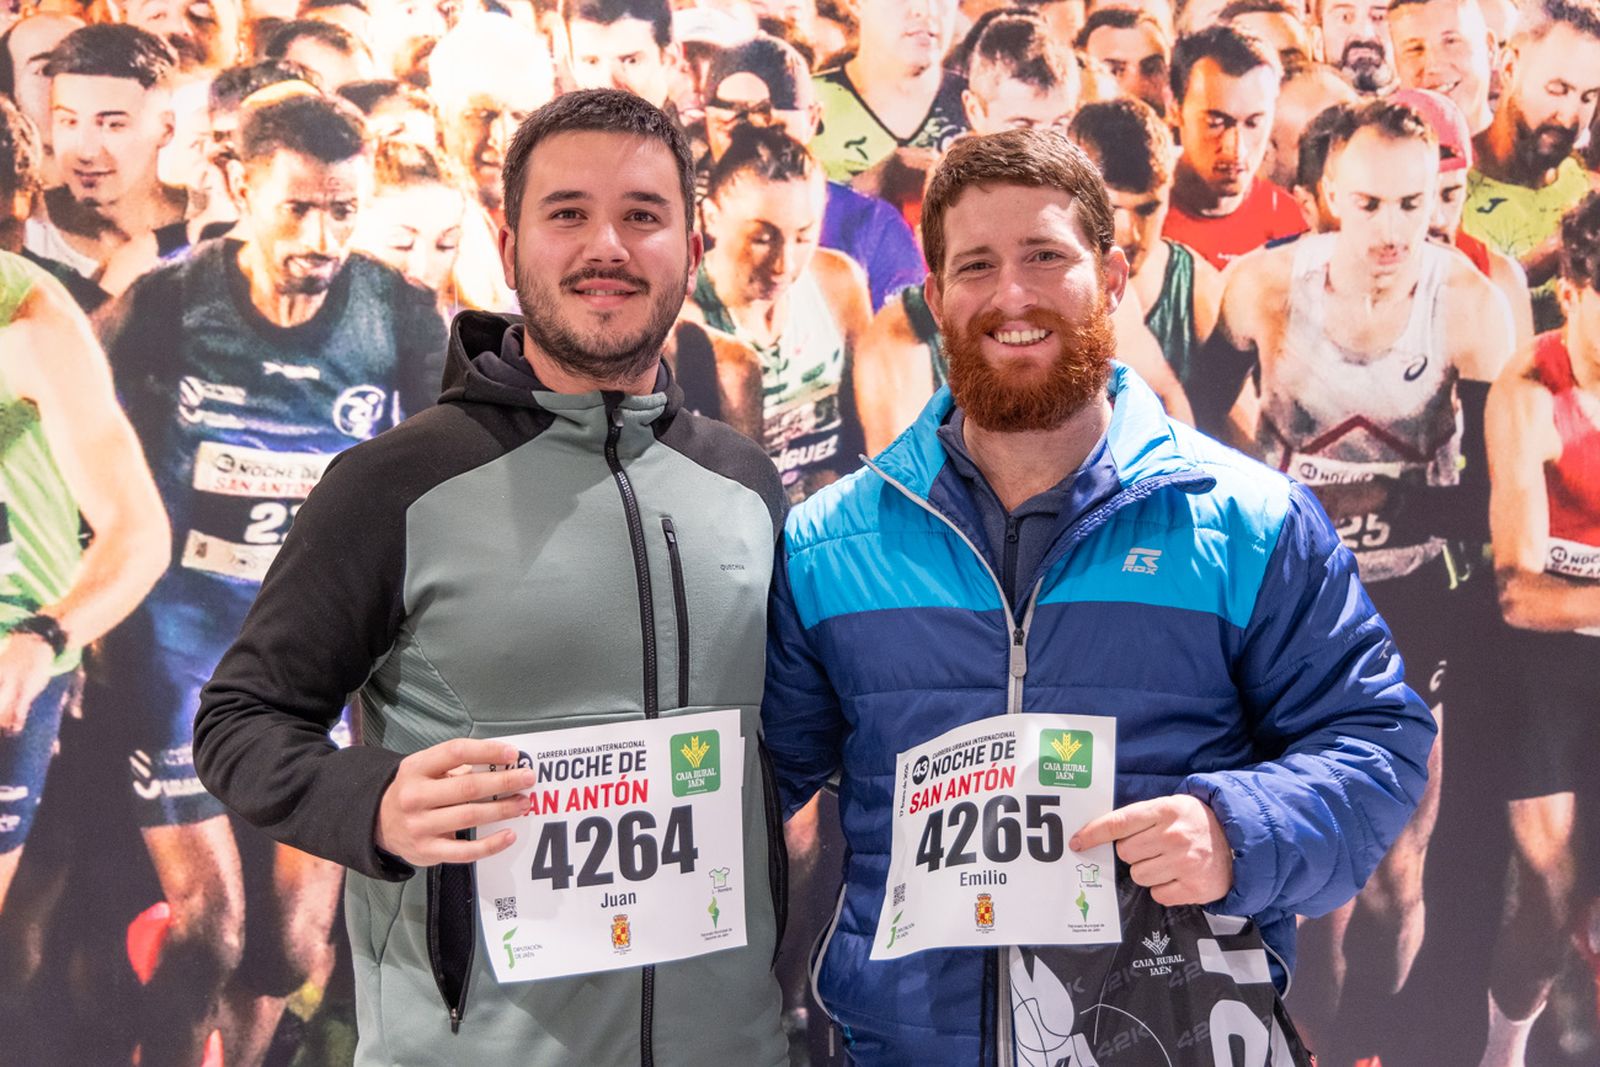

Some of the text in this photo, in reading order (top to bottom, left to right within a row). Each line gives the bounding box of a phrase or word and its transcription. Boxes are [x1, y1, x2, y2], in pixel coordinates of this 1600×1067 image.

[244, 502, 300, 544] 2
[537, 740, 645, 760] CARRERA URBANA INTERNACIONAL
[930, 739, 1016, 780] NOCHE DE
[932, 731, 1016, 760] CARRERA URBANA INTERNACIONAL
[537, 750, 647, 783] NOCHE DE
[912, 761, 929, 779] 43
[1042, 761, 1089, 773] CAJA RURAL
[524, 774, 649, 817] AN ANTÓN
[909, 762, 1016, 815] SAN ANTÓN
[531, 804, 699, 890] 4264
[915, 794, 1064, 873] 4265
[960, 869, 1007, 887] Emilio
[600, 891, 637, 909] Juan
[1132, 954, 1185, 968] CAJA RURAL
[1169, 960, 1202, 988] 42
[1177, 1020, 1210, 1049] 42
